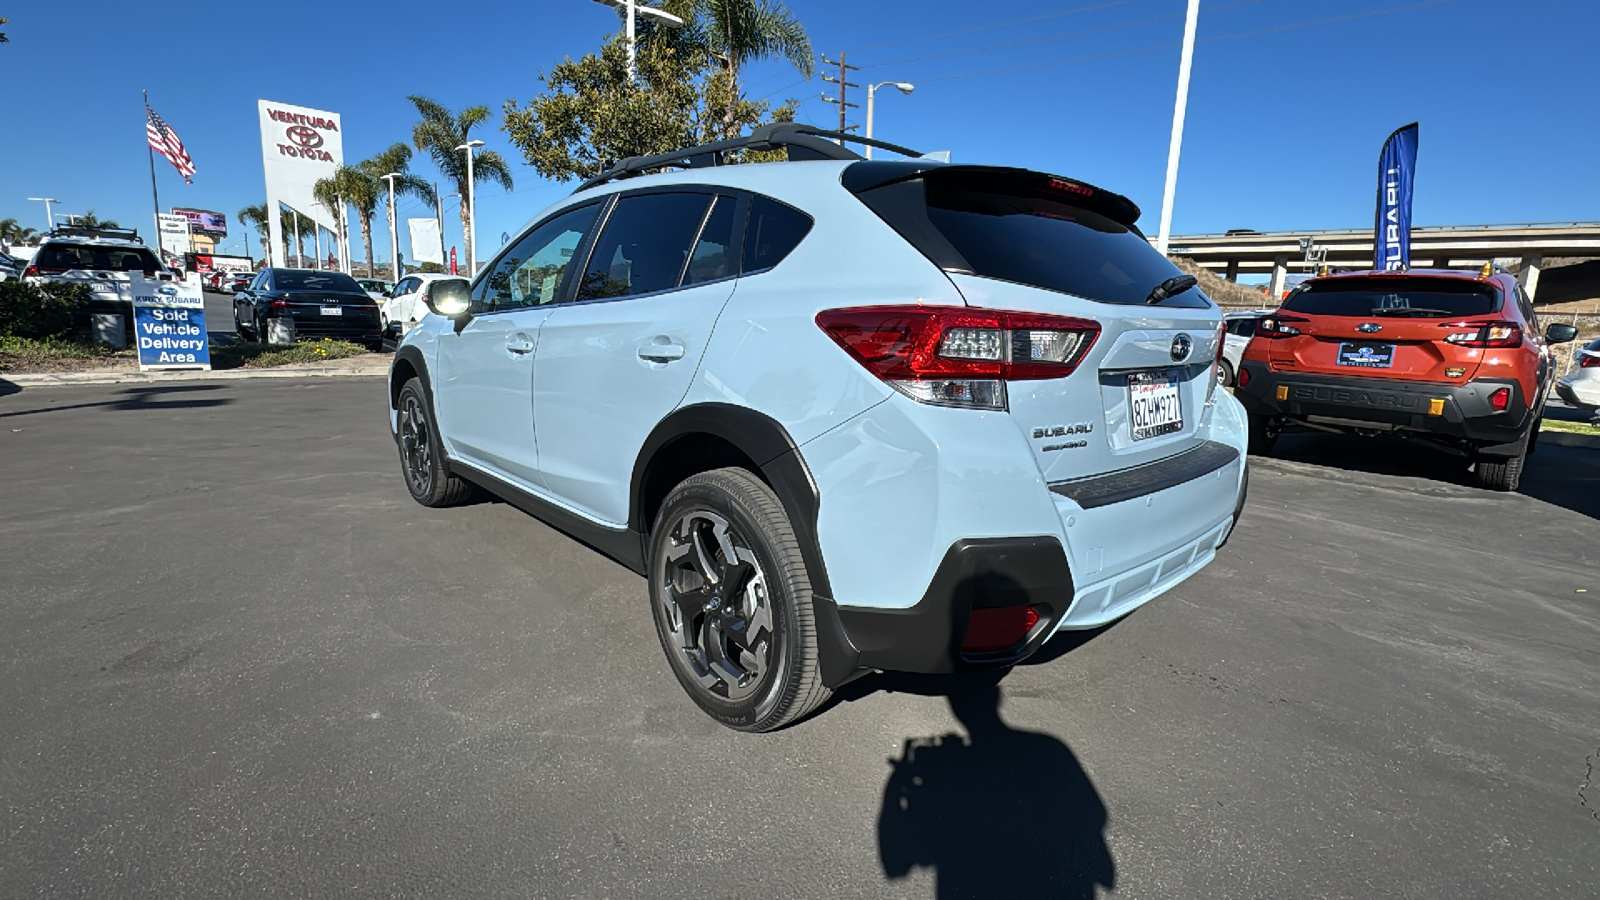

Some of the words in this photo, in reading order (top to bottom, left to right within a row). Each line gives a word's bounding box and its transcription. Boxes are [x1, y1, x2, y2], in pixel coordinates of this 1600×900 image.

[266, 107, 339, 132] VENTURA
[276, 142, 334, 163] TOYOTA
[1386, 166, 1402, 271] SUBARU
[135, 295, 162, 303] KIRBY
[166, 296, 201, 304] SUBARU
[152, 309, 188, 321] Sold
[142, 322, 200, 336] Vehicle
[140, 336, 204, 351] Delivery
[159, 351, 196, 363] Area
[1293, 387, 1421, 409] SUBARU
[1134, 393, 1178, 427] 8ZHM927
[1033, 422, 1093, 439] SUBARU
